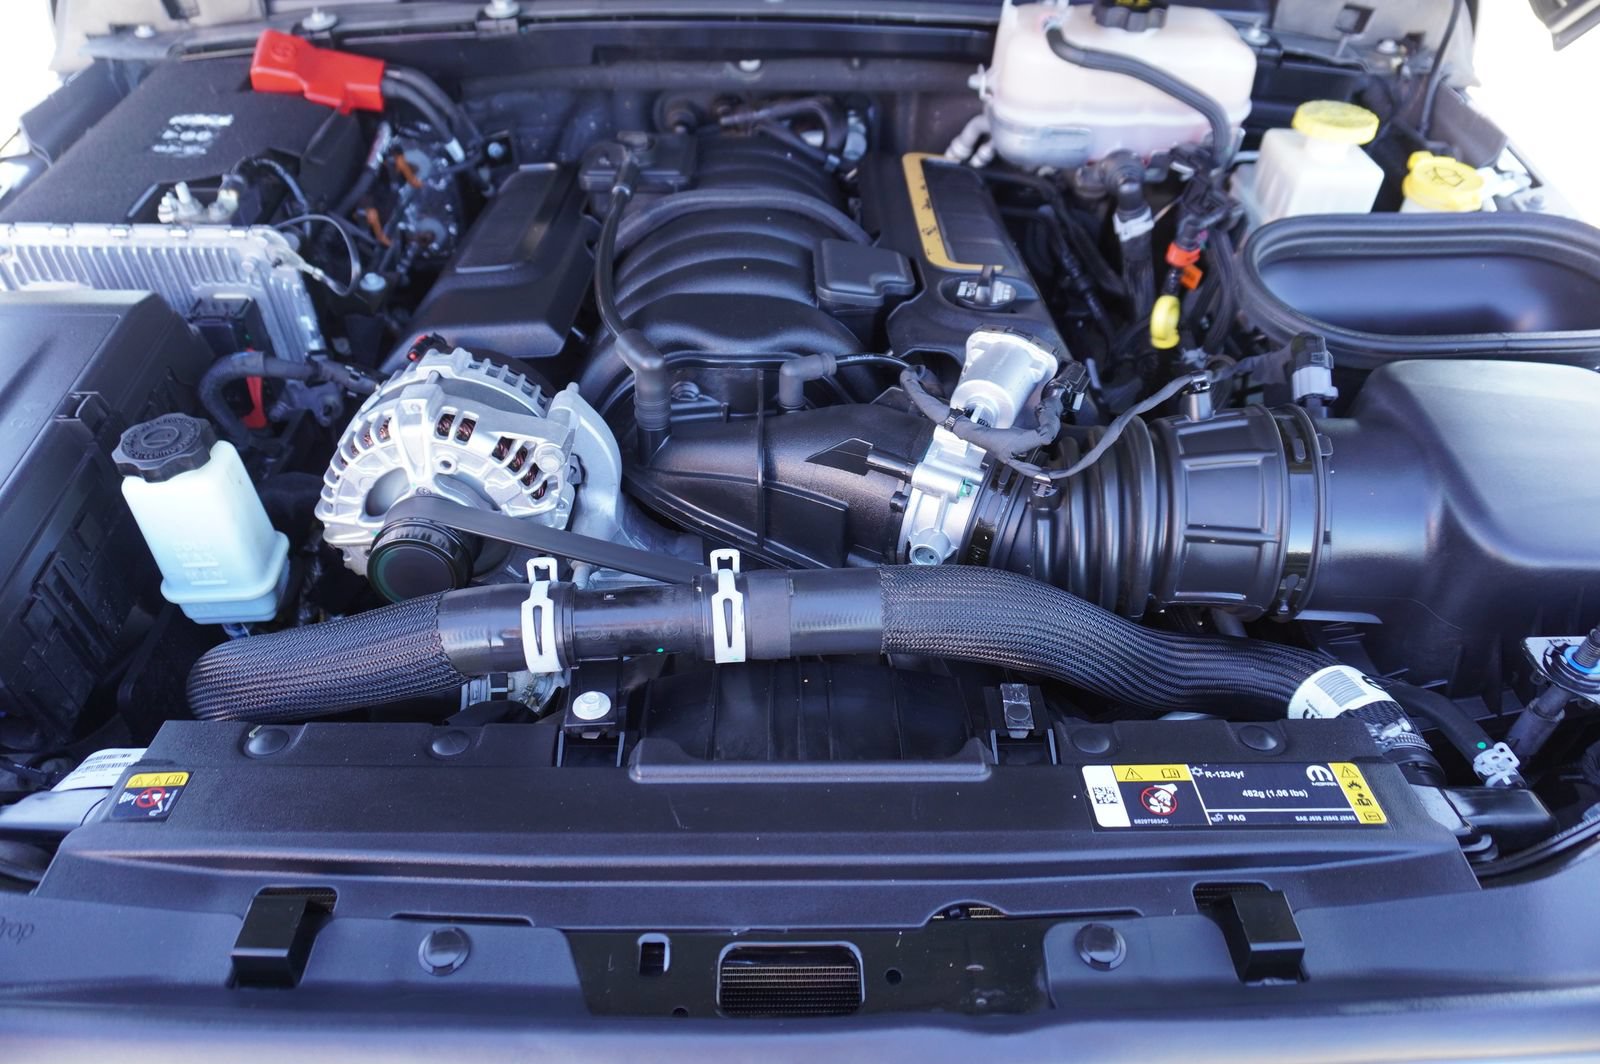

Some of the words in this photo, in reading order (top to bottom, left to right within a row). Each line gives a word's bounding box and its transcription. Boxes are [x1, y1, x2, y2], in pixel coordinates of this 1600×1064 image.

[1204, 770, 1245, 780] R-1234yf
[1242, 789, 1265, 799] 482g
[1289, 789, 1308, 799] lbs)
[1227, 814, 1247, 822] PAG
